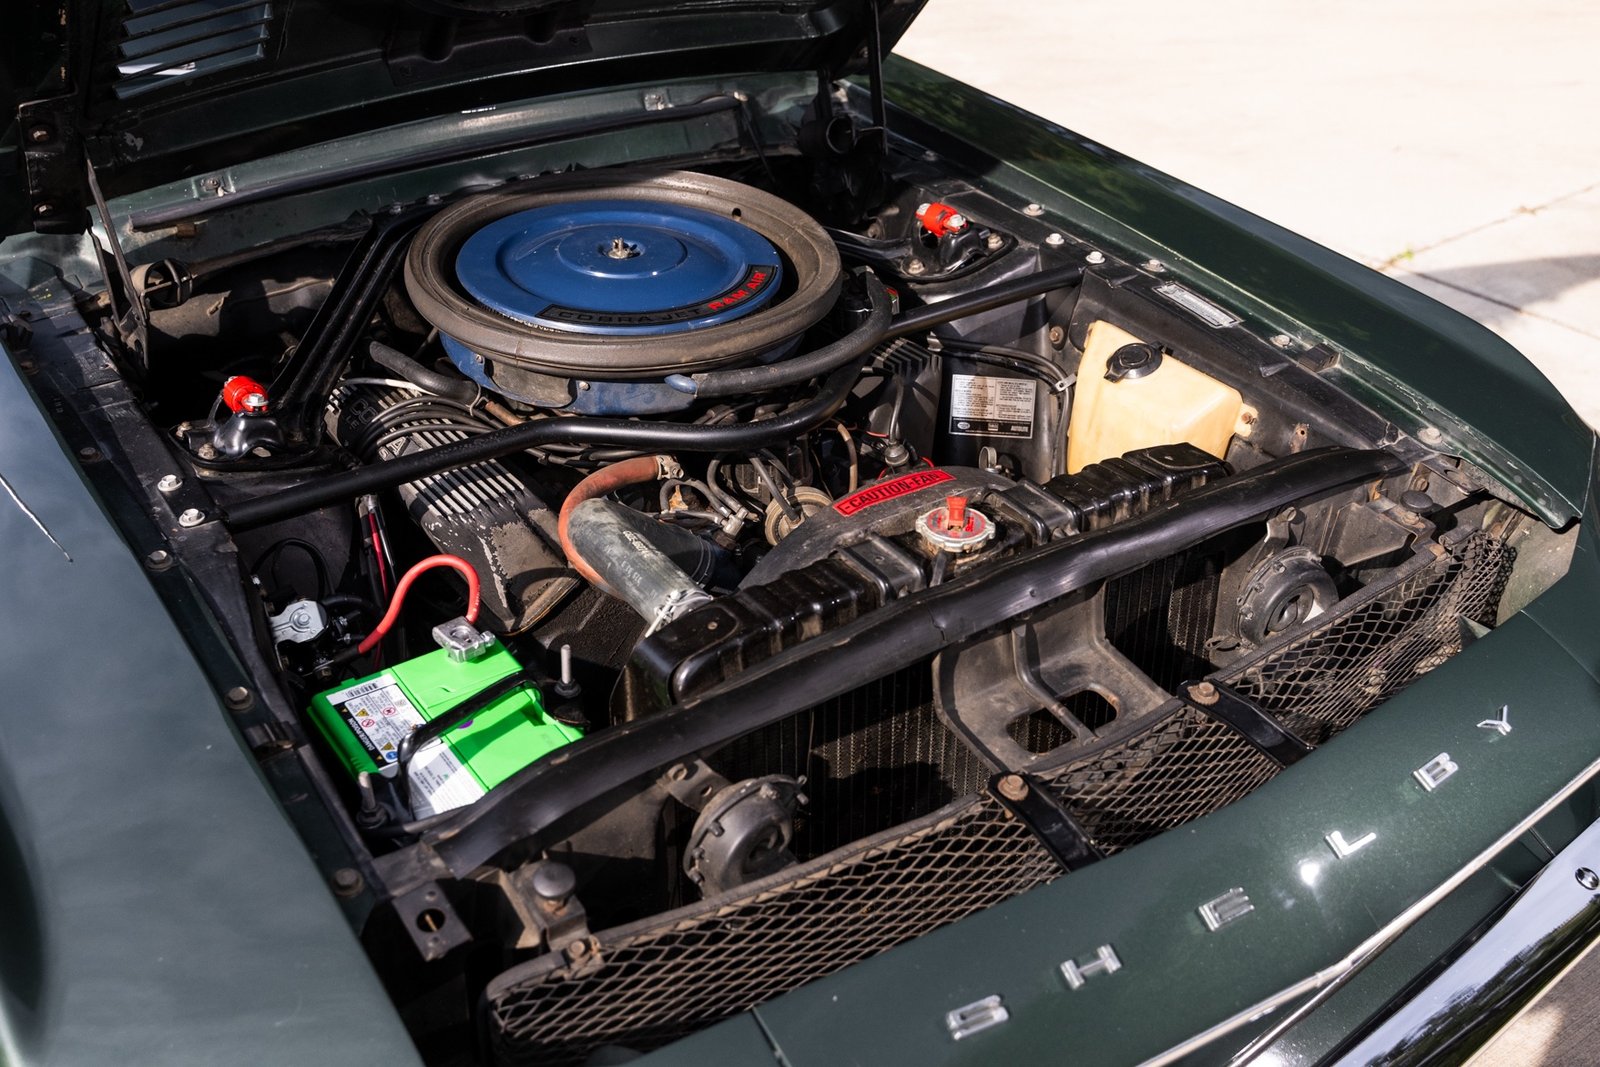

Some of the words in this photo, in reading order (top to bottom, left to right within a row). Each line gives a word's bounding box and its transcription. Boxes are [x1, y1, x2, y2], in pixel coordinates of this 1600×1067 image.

[558, 310, 652, 323] COBRA
[661, 308, 702, 320] JET
[707, 289, 749, 311] RAM
[746, 271, 767, 290] AIR
